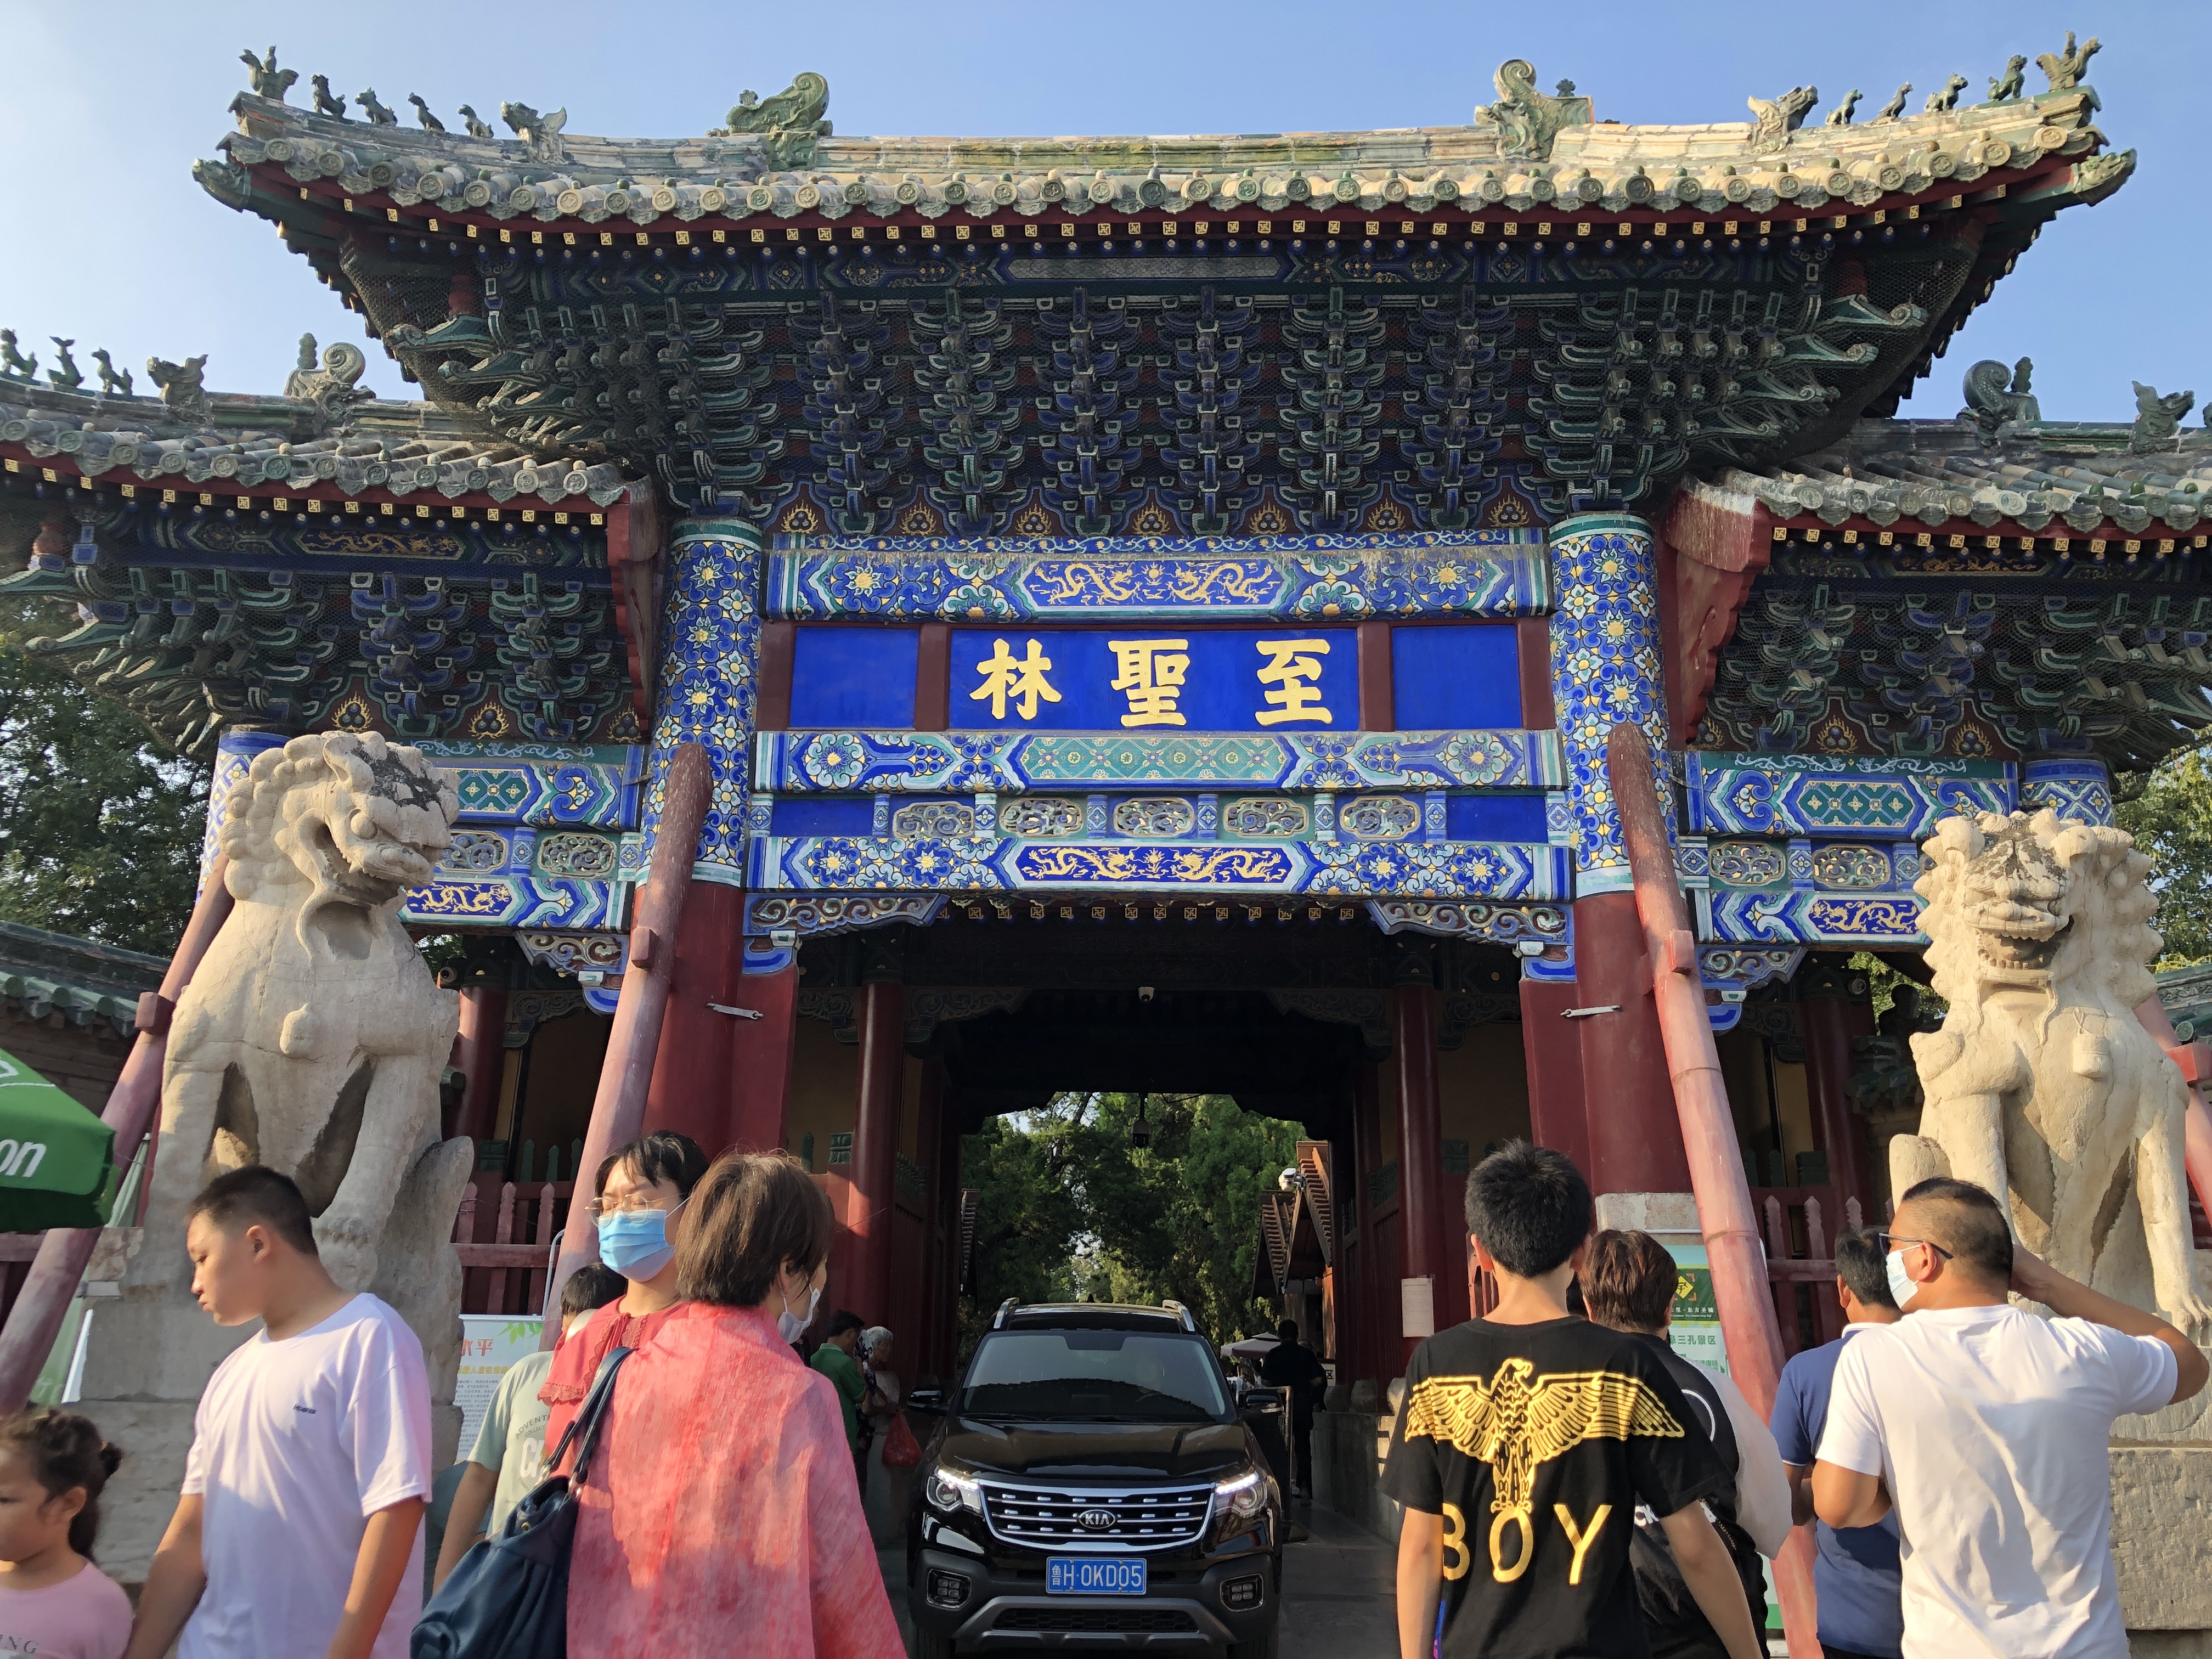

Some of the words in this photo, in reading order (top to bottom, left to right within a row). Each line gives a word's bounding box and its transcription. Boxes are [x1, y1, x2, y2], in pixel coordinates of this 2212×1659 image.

[515, 1414, 550, 1440] ADVENT
[1085, 1513, 1110, 1525] KIA
[1442, 1502, 1612, 1585] BOY
